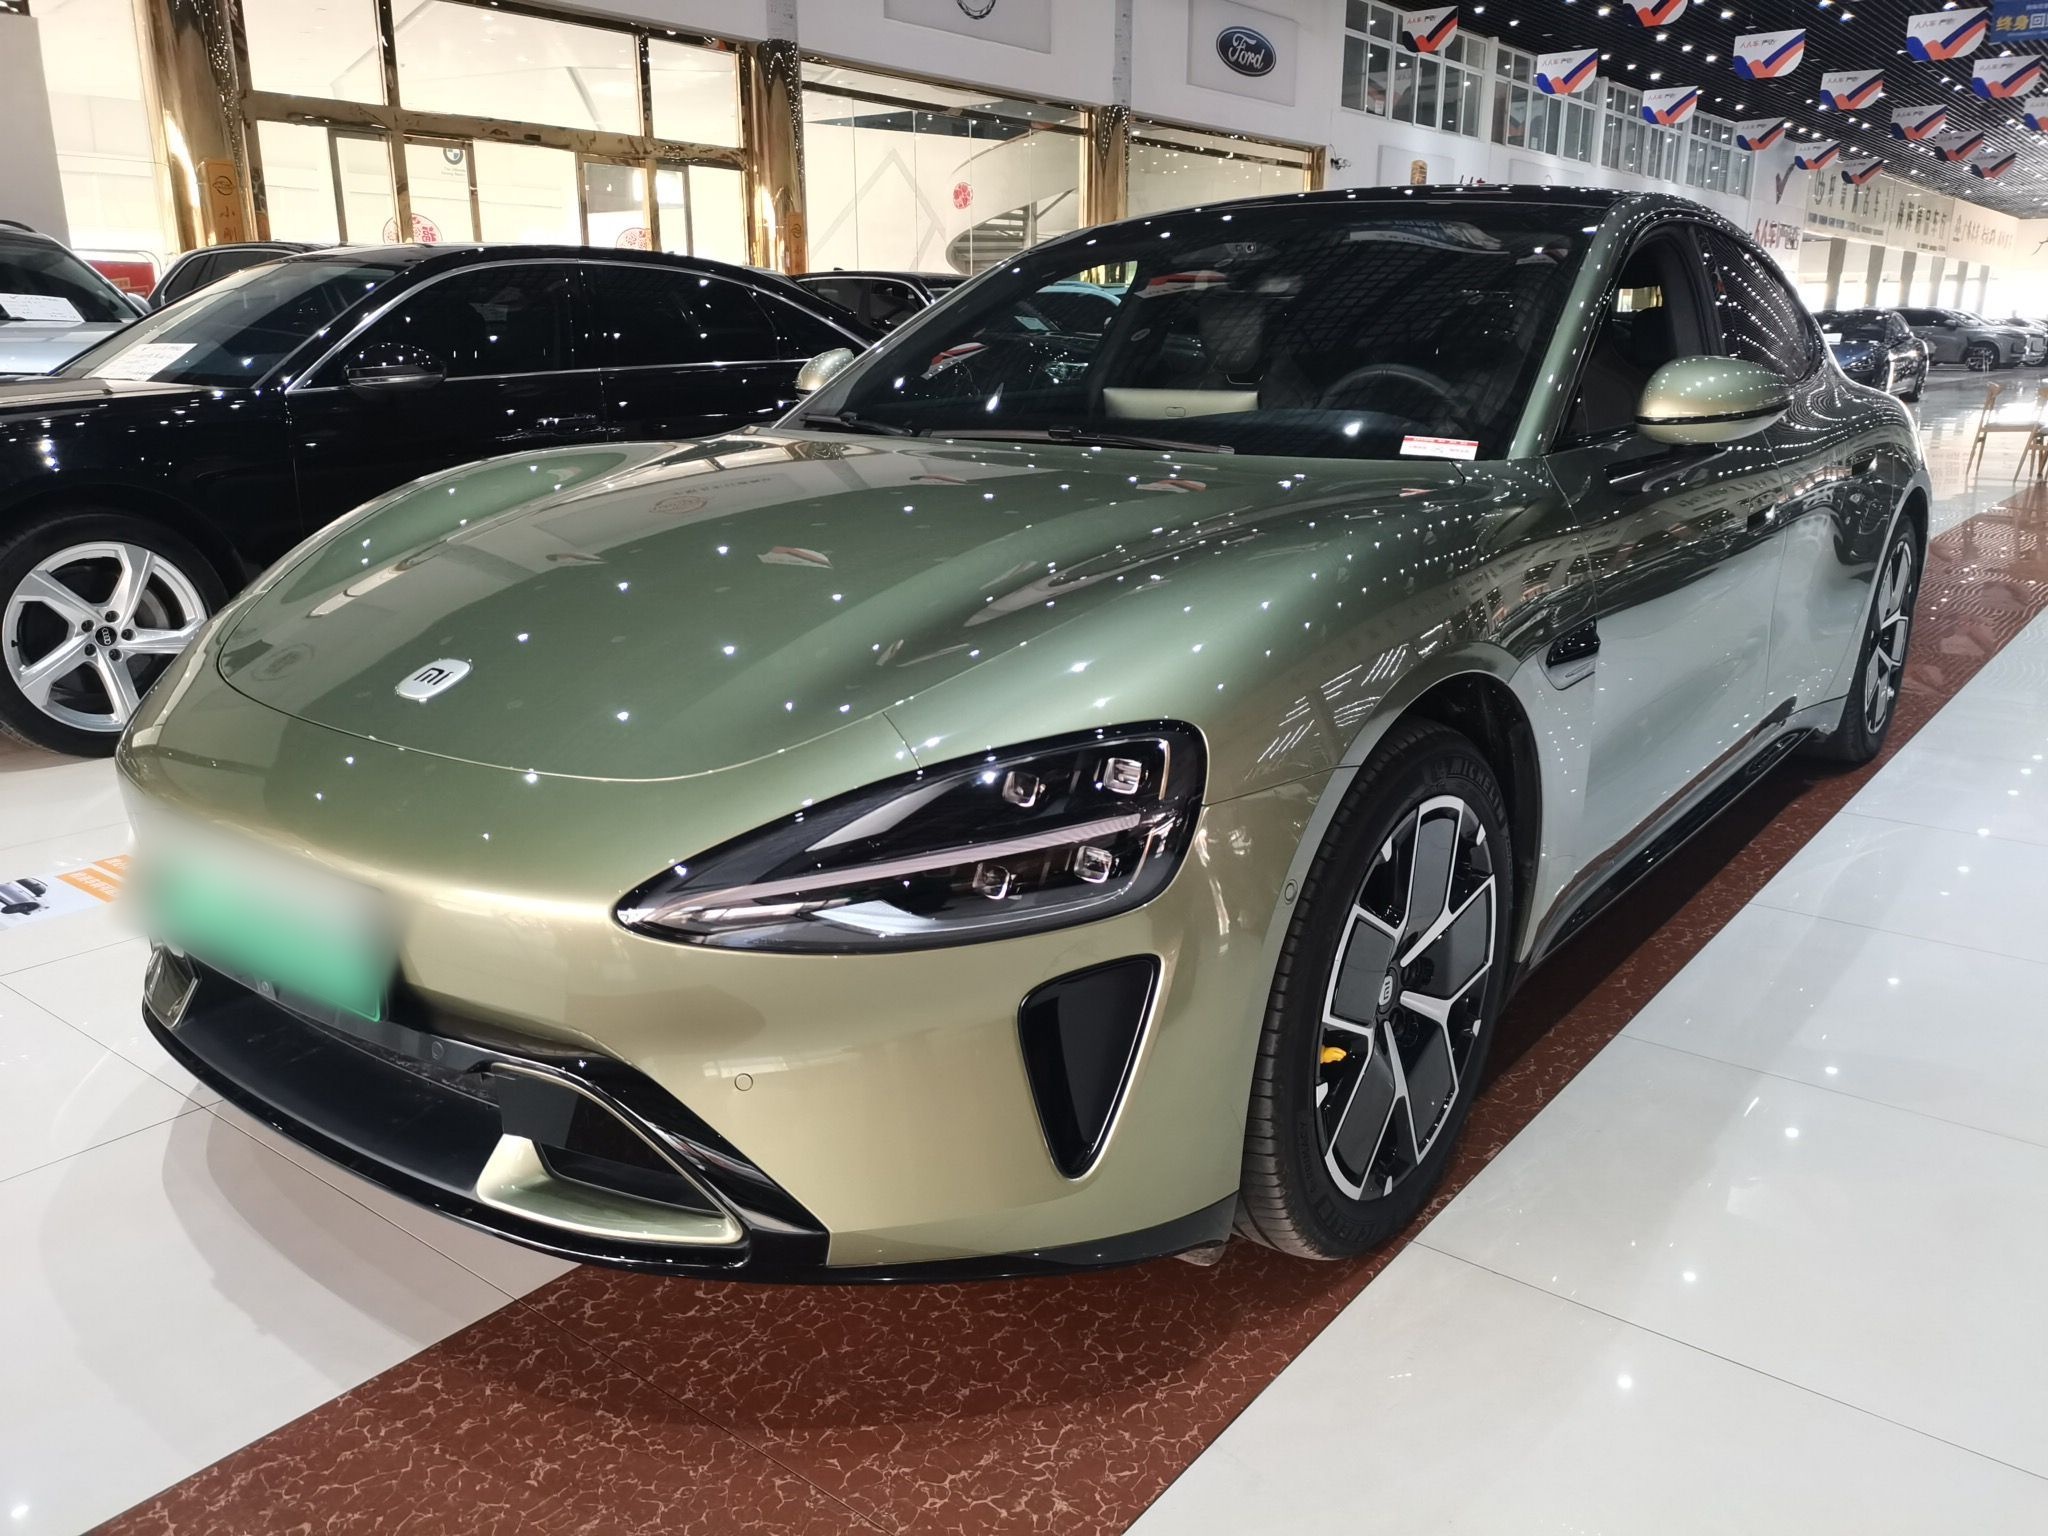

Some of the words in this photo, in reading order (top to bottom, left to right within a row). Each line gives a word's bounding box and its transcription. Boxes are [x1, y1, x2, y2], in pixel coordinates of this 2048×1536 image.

[1996, 13, 2048, 31] 终身回
[1228, 33, 1265, 69] Ford
